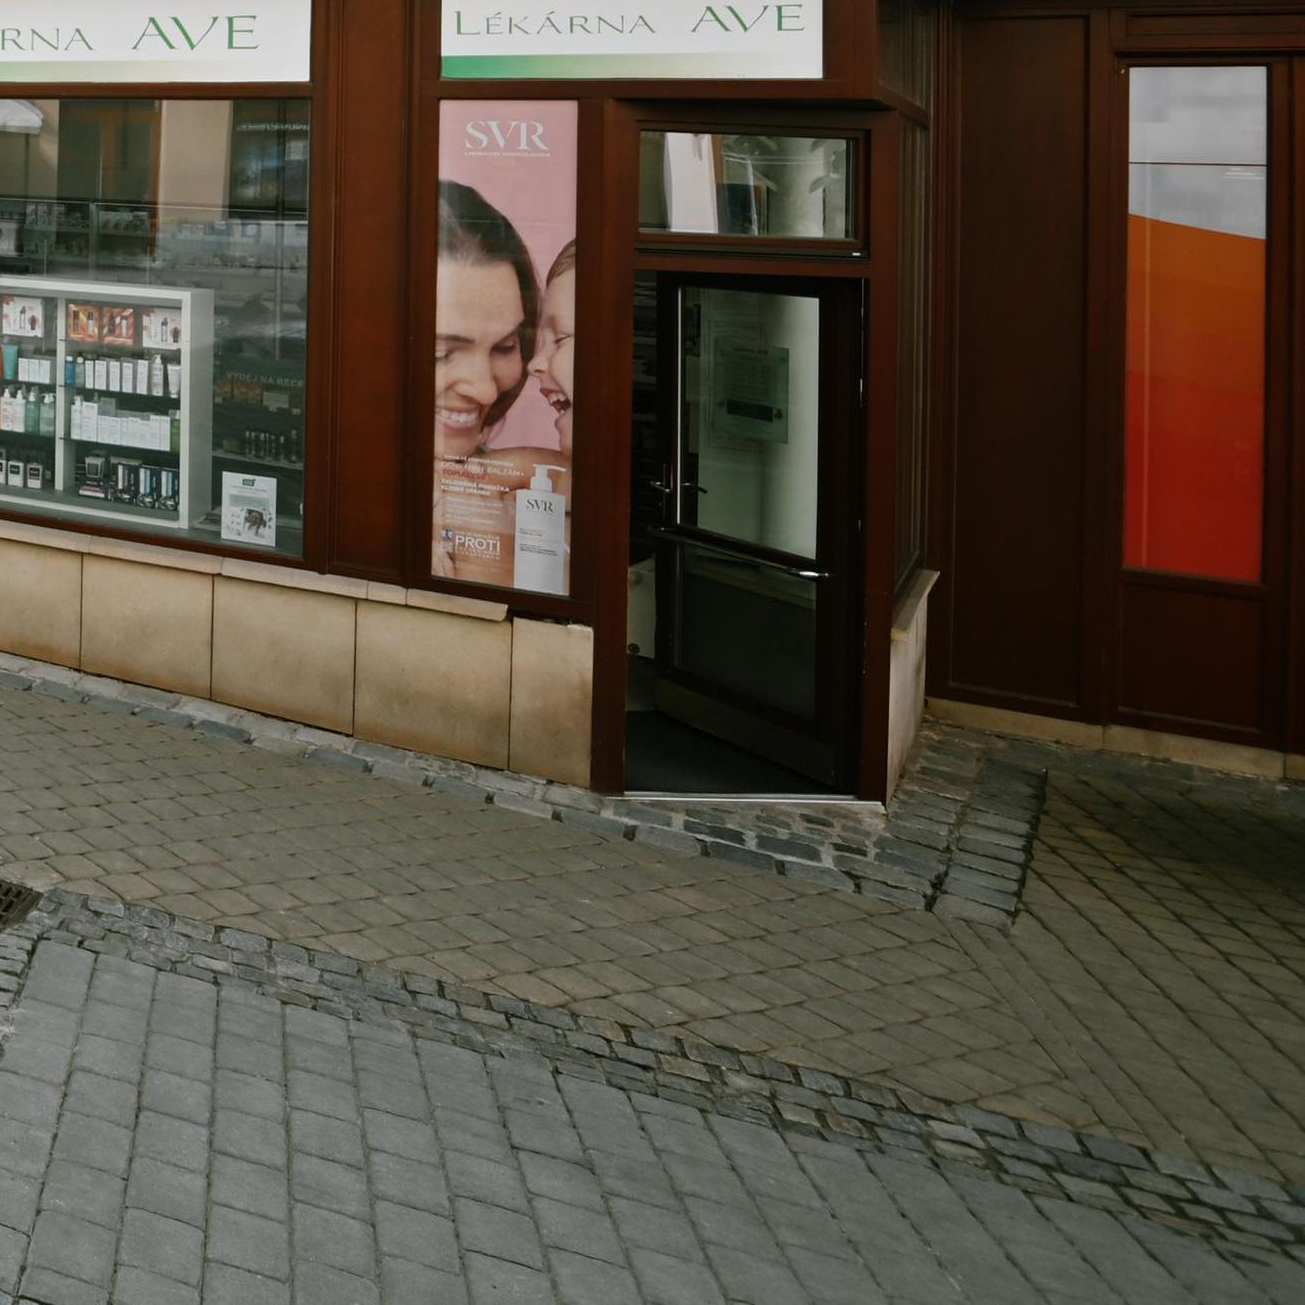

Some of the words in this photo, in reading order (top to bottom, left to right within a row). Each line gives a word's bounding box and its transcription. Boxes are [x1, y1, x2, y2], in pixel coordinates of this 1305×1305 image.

[131, 14, 260, 51] AVE
[690, 3, 806, 33] AVE
[465, 119, 551, 151] SVR
[525, 498, 556, 513] SVR
[455, 534, 501, 552] PROTI
